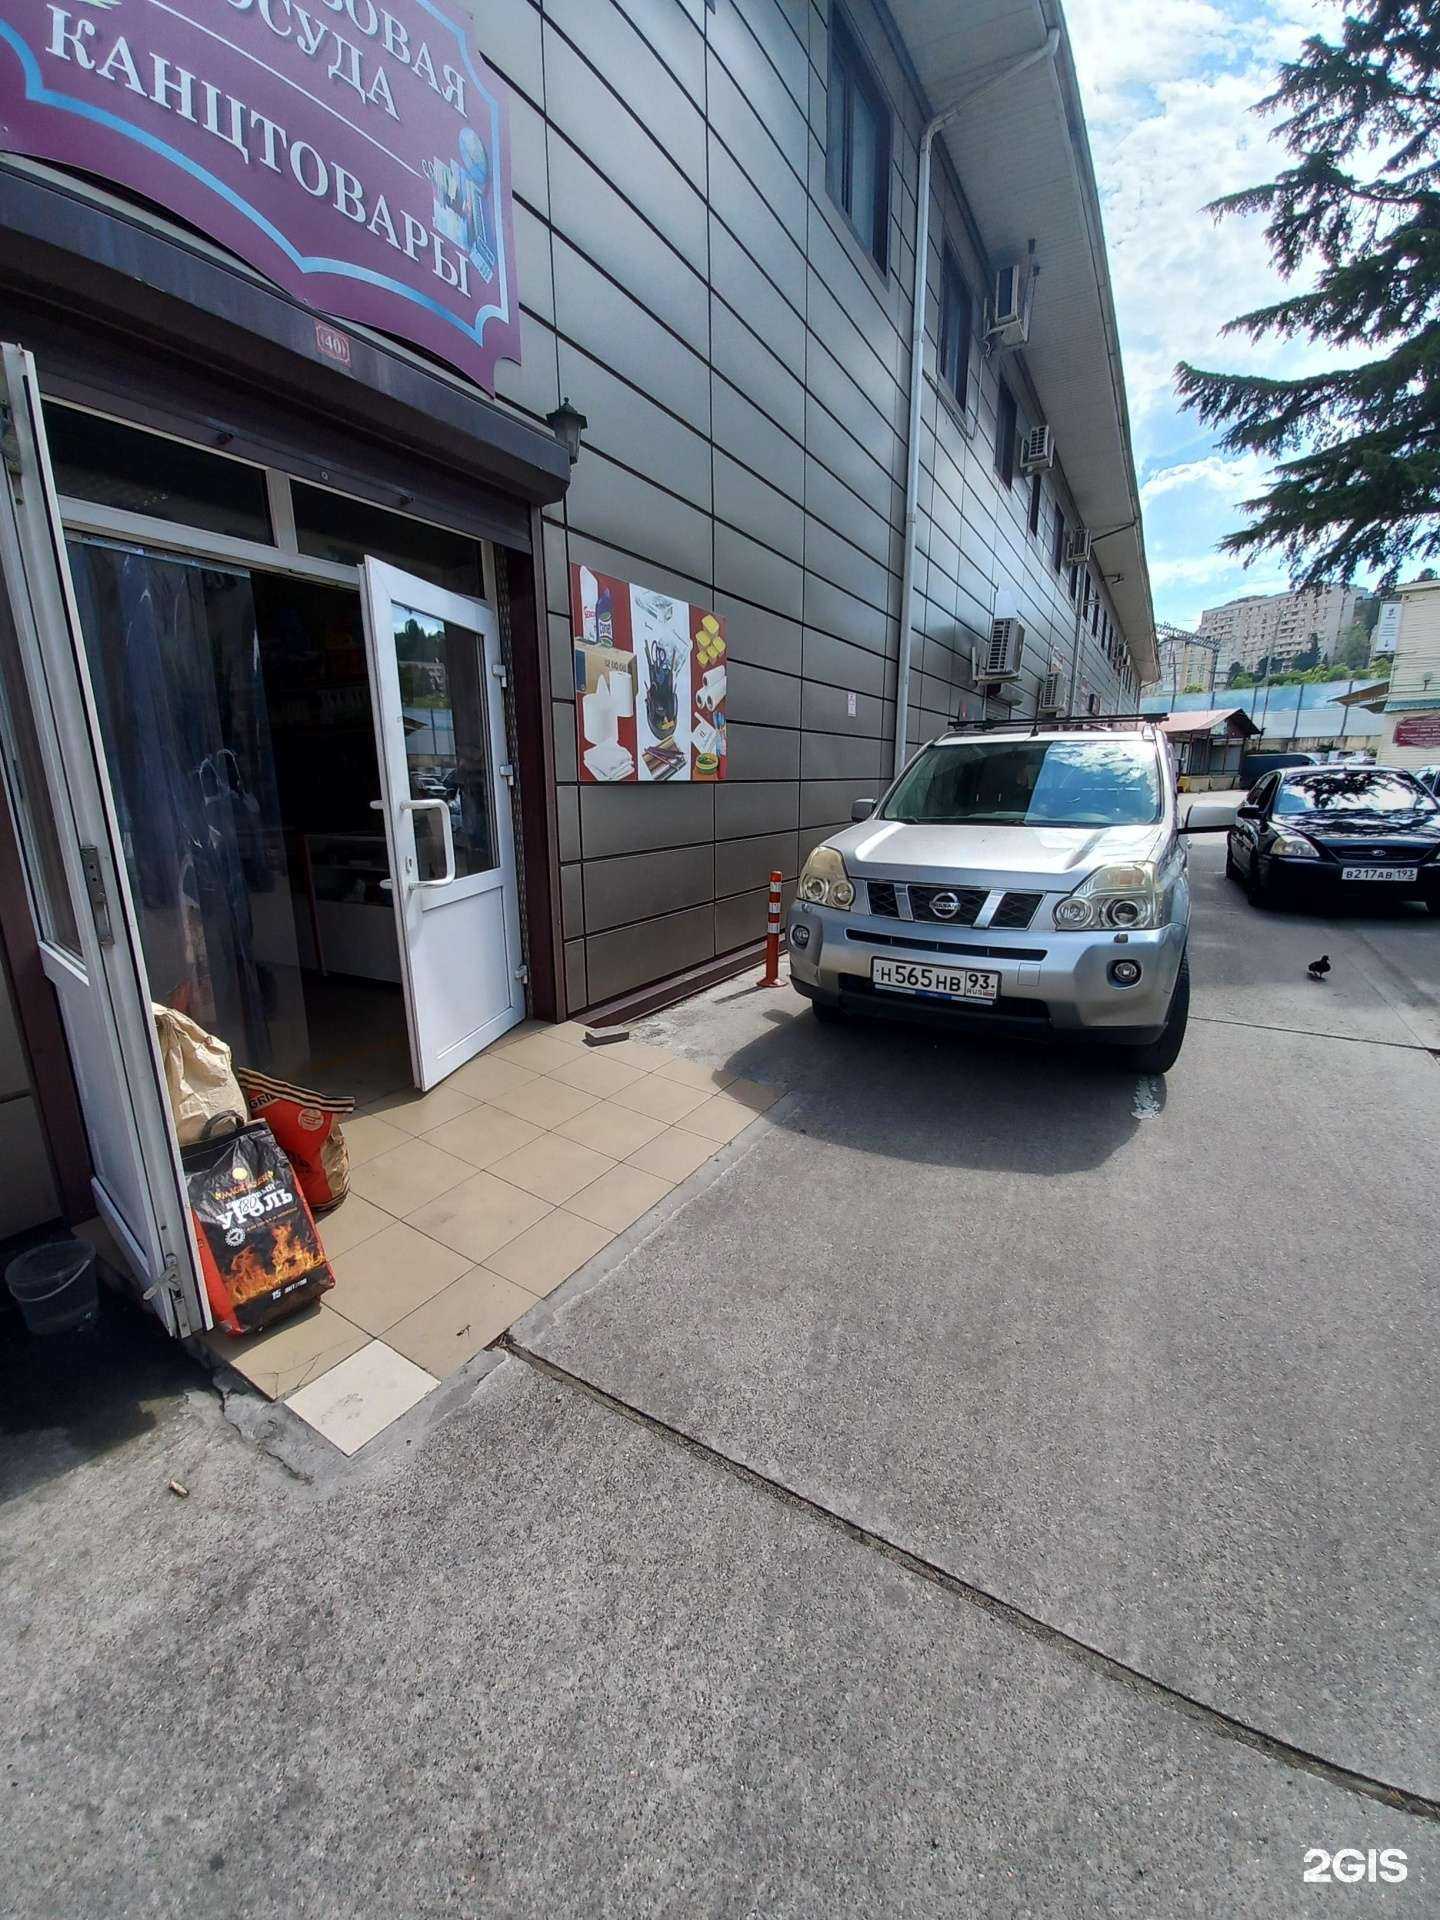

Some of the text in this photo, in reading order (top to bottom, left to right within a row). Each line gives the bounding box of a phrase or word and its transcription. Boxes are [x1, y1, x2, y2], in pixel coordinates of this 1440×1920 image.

[226, 0, 400, 122] СУДА
[322, 0, 468, 118] ОВАЯ
[46, 7, 473, 298] КАНЦТОВАРЫ
[968, 973, 991, 990] 93
